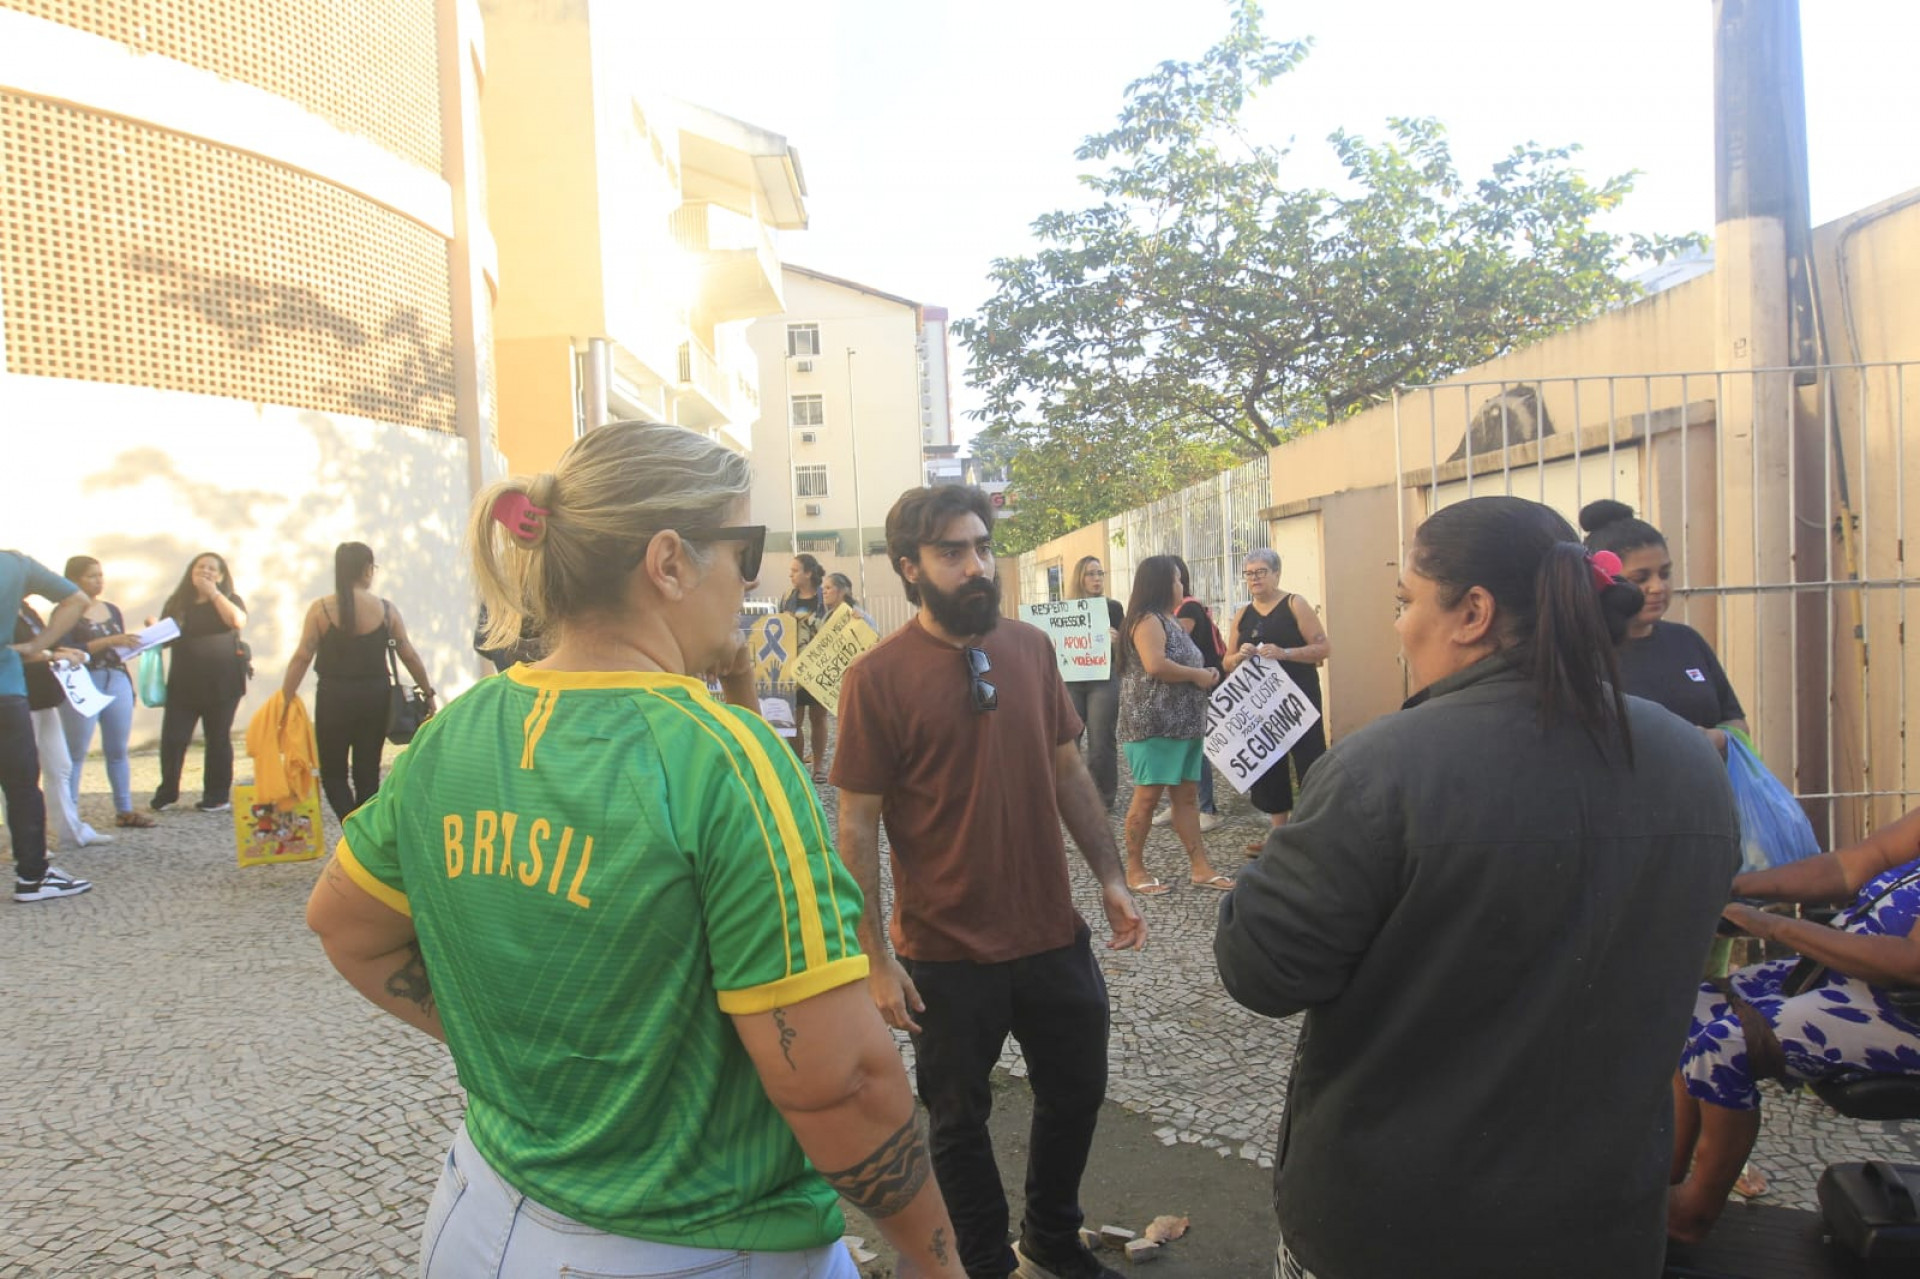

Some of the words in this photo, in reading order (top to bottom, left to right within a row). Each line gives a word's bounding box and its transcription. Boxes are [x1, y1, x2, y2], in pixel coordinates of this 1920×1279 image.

[1206, 731, 1229, 758] NÃO
[1225, 705, 1255, 737] PODE
[1250, 672, 1285, 710] CUSTAR
[1229, 692, 1307, 779] SEGURANÇA
[443, 809, 594, 909] BRASIL
